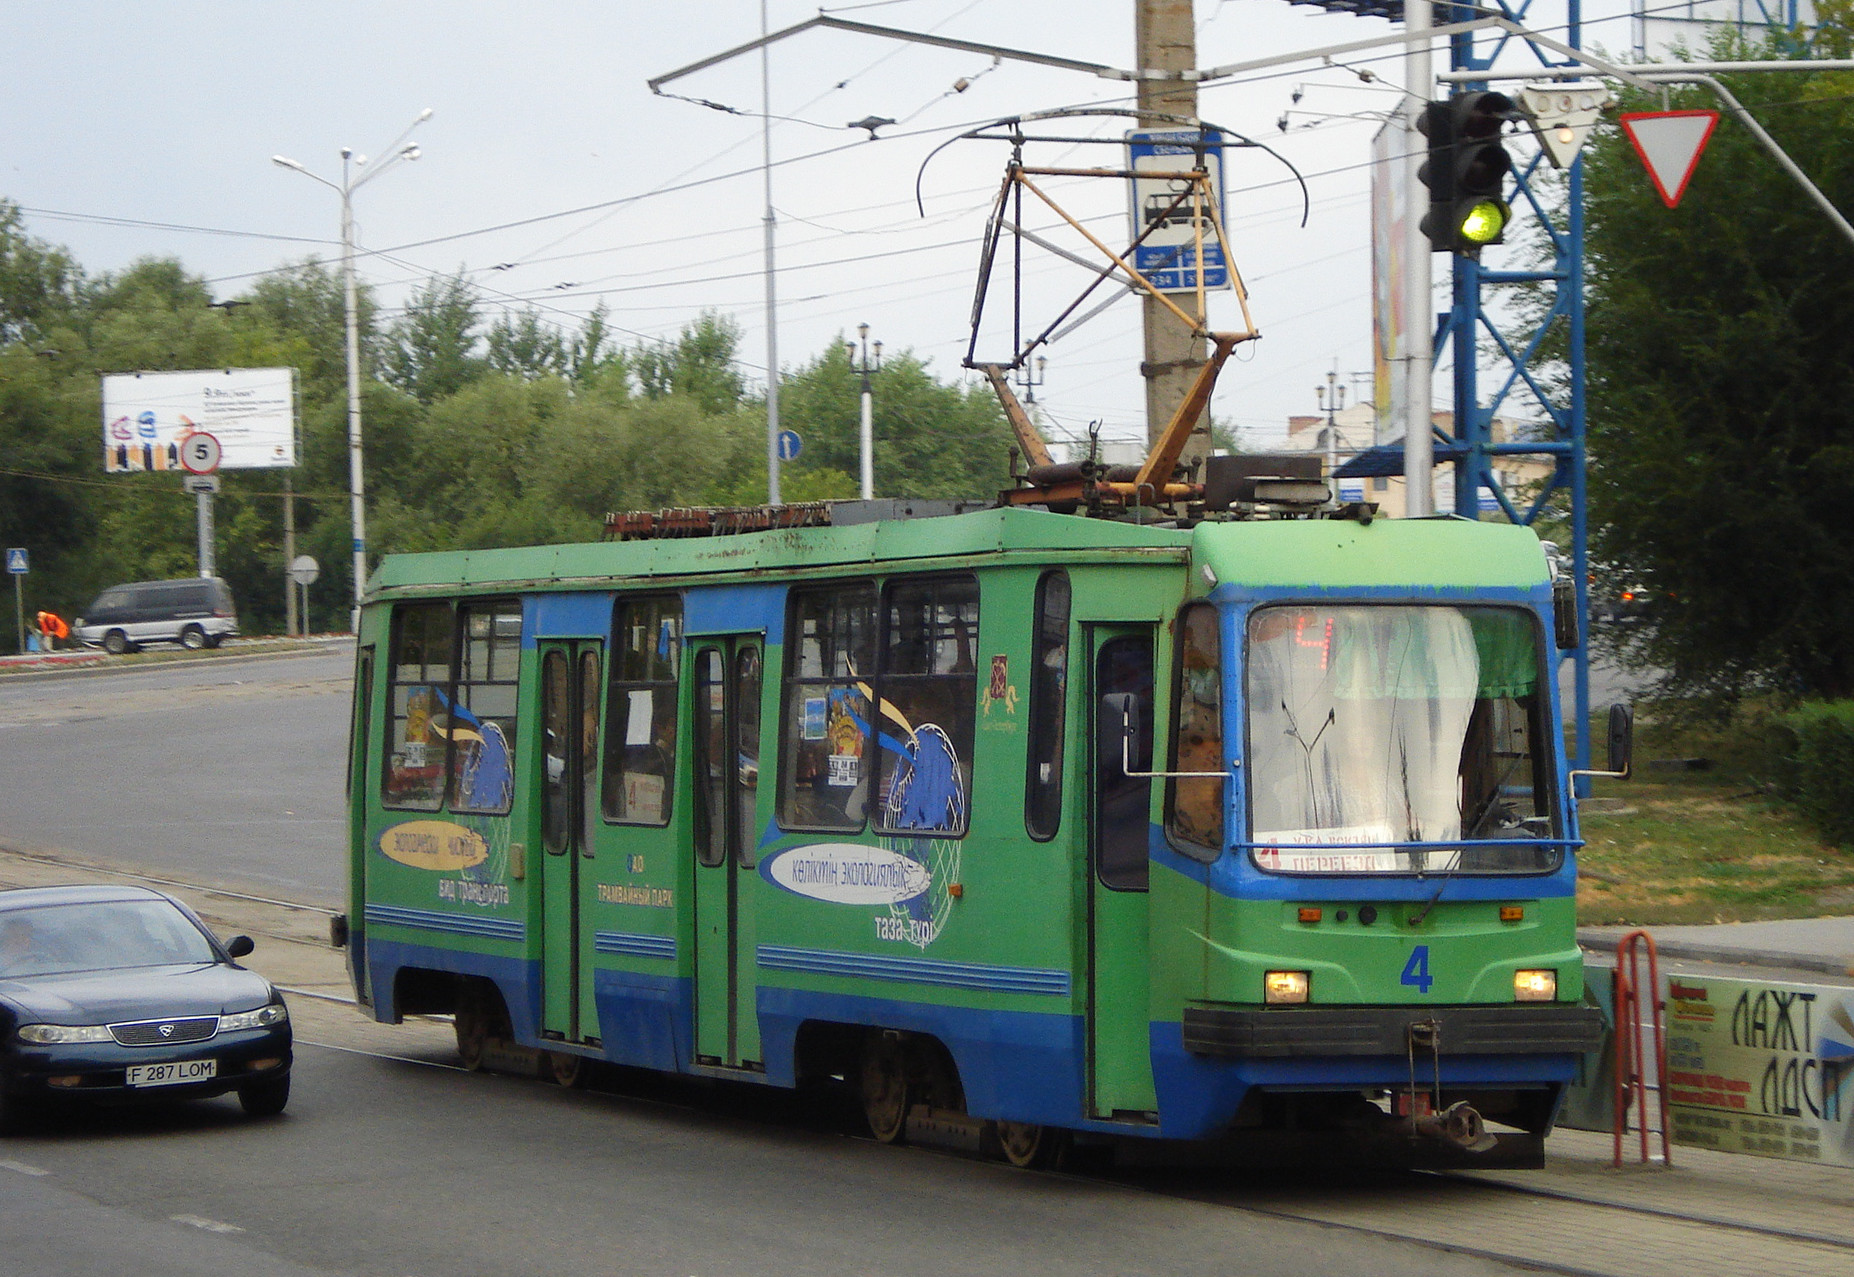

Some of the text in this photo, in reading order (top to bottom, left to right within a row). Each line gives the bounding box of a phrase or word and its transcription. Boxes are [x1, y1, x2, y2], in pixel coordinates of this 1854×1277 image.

[195, 443, 209, 460] 5
[1296, 616, 1335, 670] 4
[1400, 945, 1434, 994] 4
[132, 1063, 212, 1082] F 287 LOM
